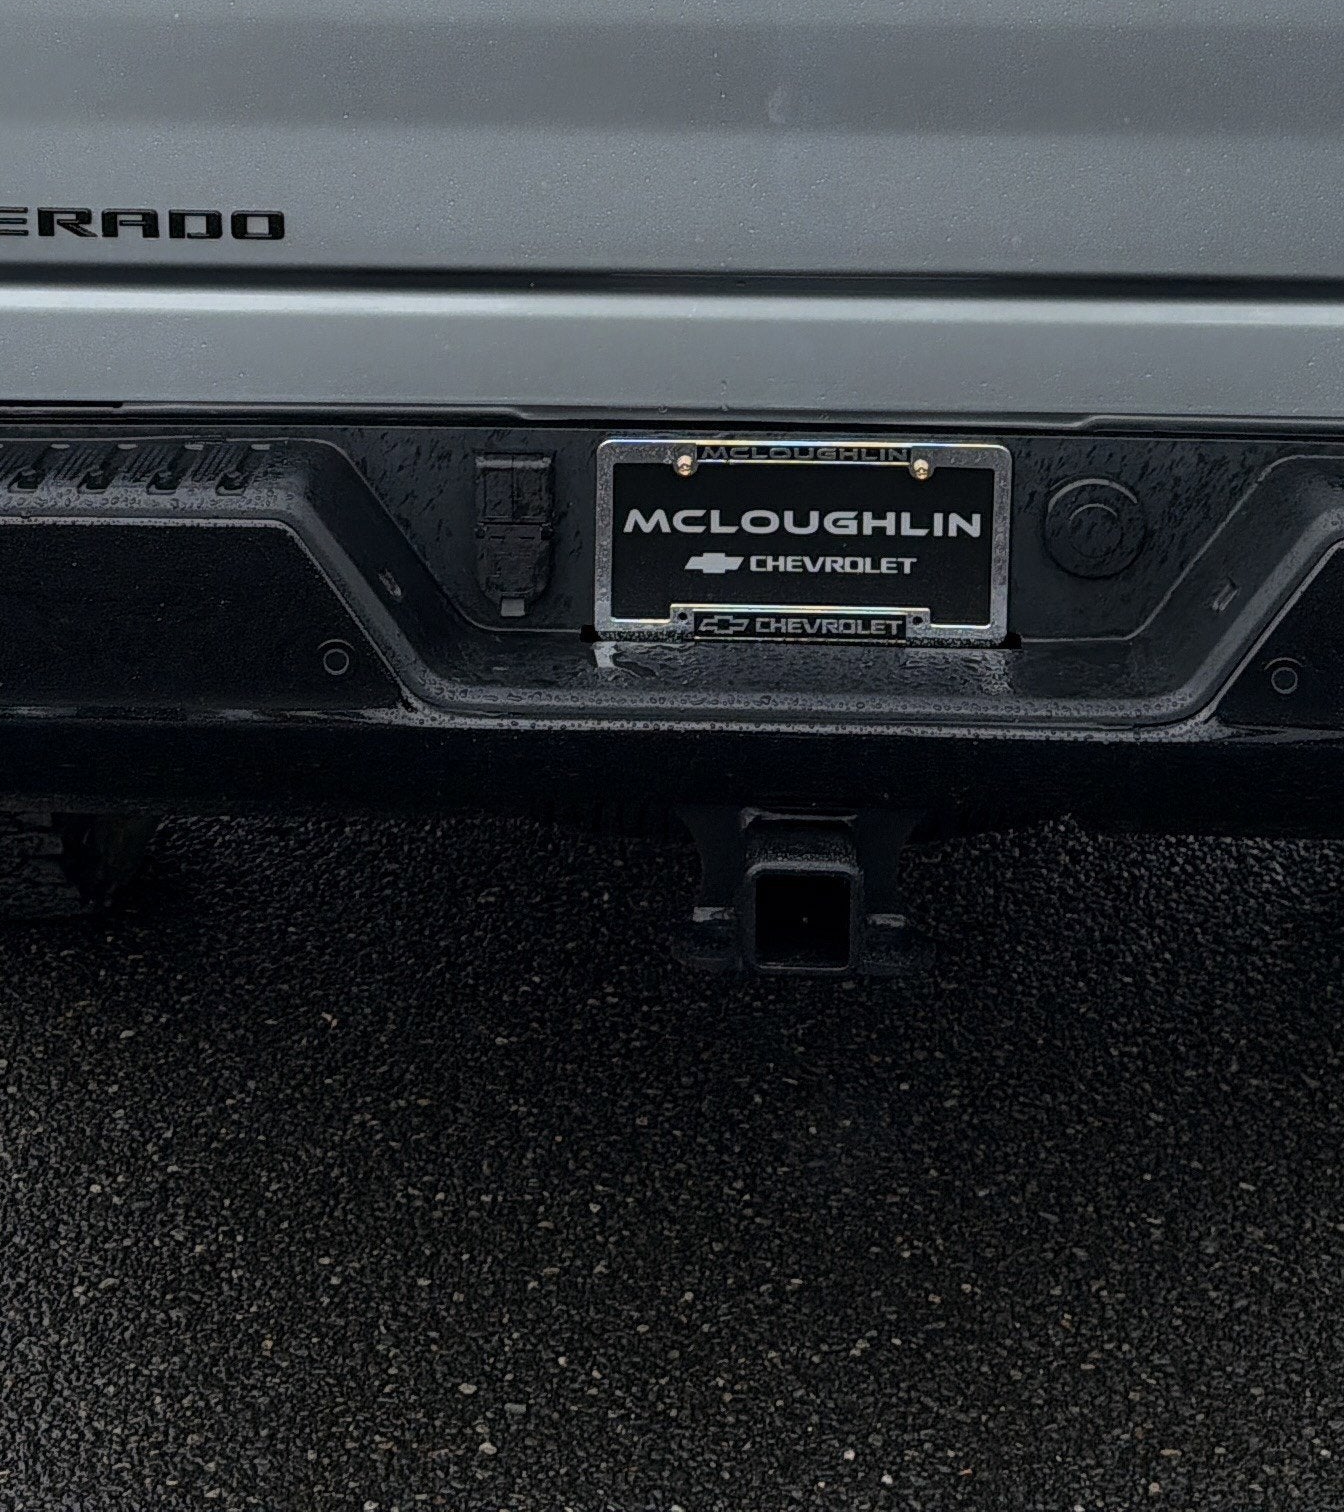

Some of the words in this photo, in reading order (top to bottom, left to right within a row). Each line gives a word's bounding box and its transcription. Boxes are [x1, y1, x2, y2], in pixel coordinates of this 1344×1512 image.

[700, 445, 910, 463] MCLOUGHLIN
[622, 507, 982, 539] MCLOUGHLIN
[749, 554, 918, 575] CHEVROLET
[755, 617, 904, 636] CHEVROLET
